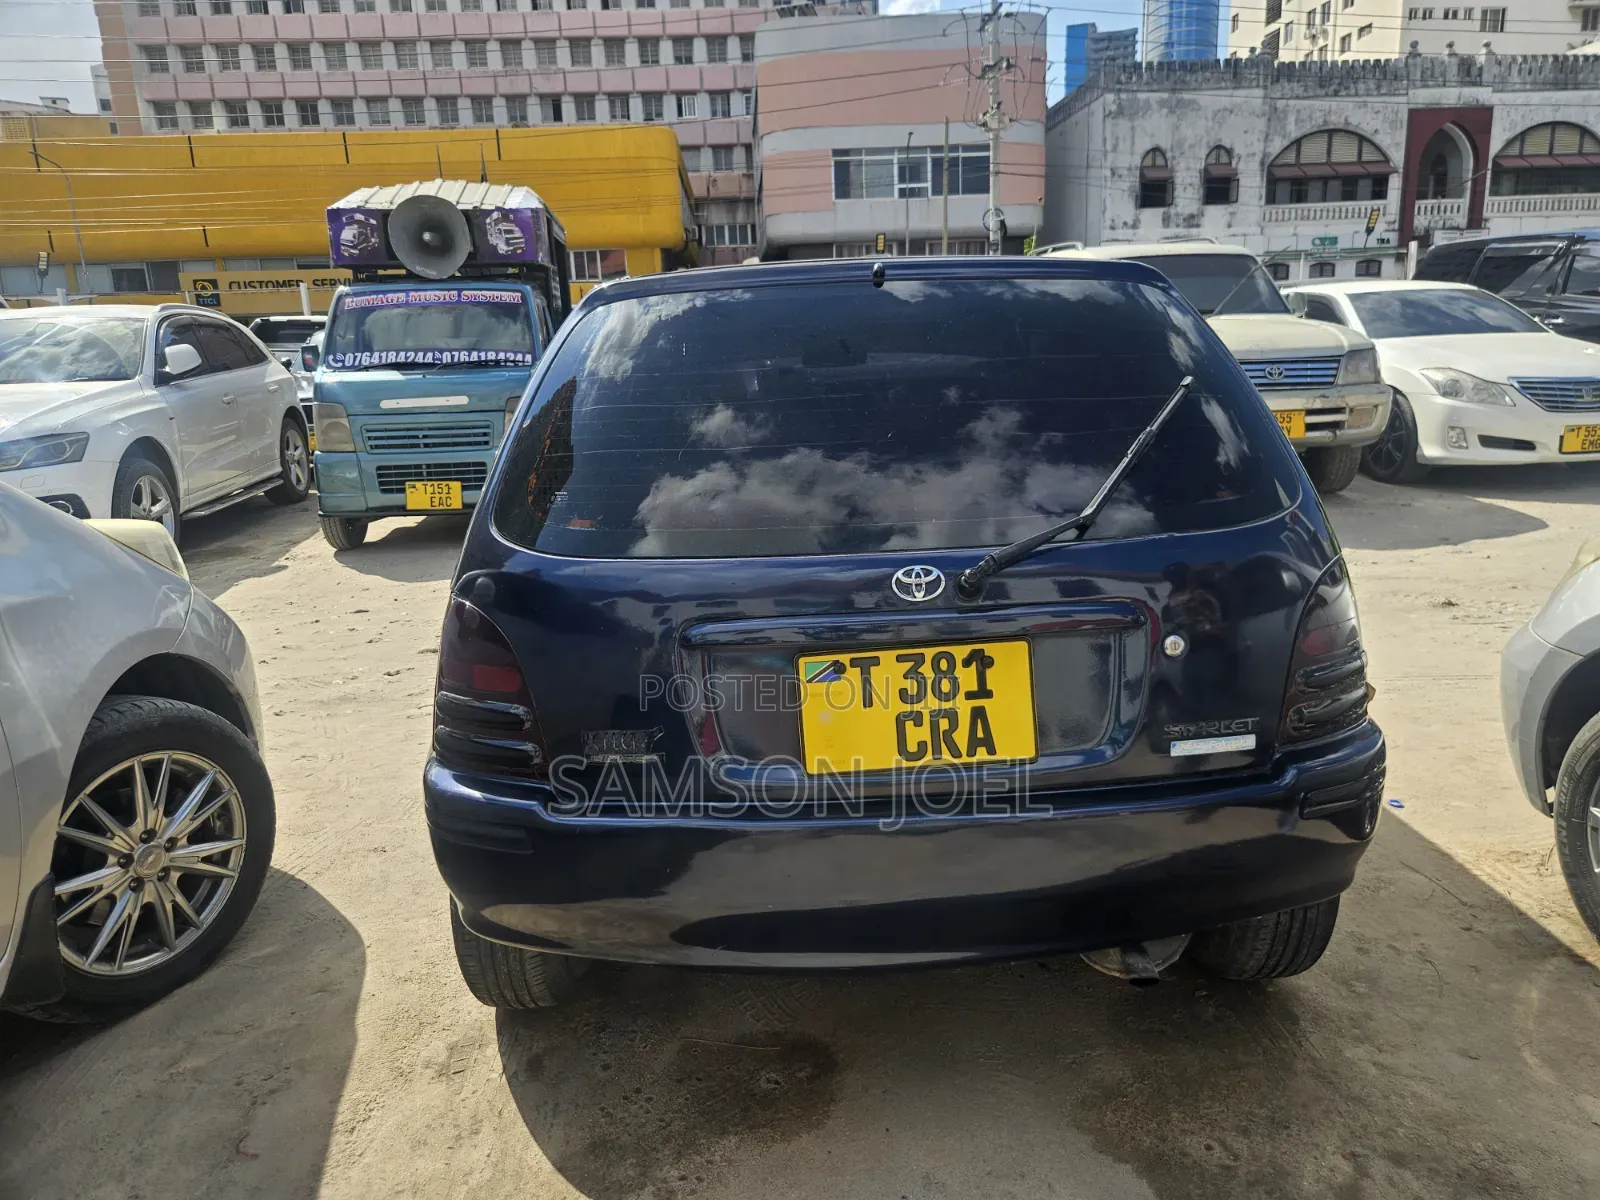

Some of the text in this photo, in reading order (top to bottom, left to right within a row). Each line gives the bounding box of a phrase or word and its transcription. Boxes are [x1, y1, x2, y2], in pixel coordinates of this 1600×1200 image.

[344, 290, 522, 309] LUMAGE MUSIC SYSTEM
[344, 351, 435, 367] 0764184244
[1575, 427, 1582, 439] T
[430, 497, 452, 507] EAC
[849, 648, 994, 708] T 381
[895, 705, 997, 762] CRA
